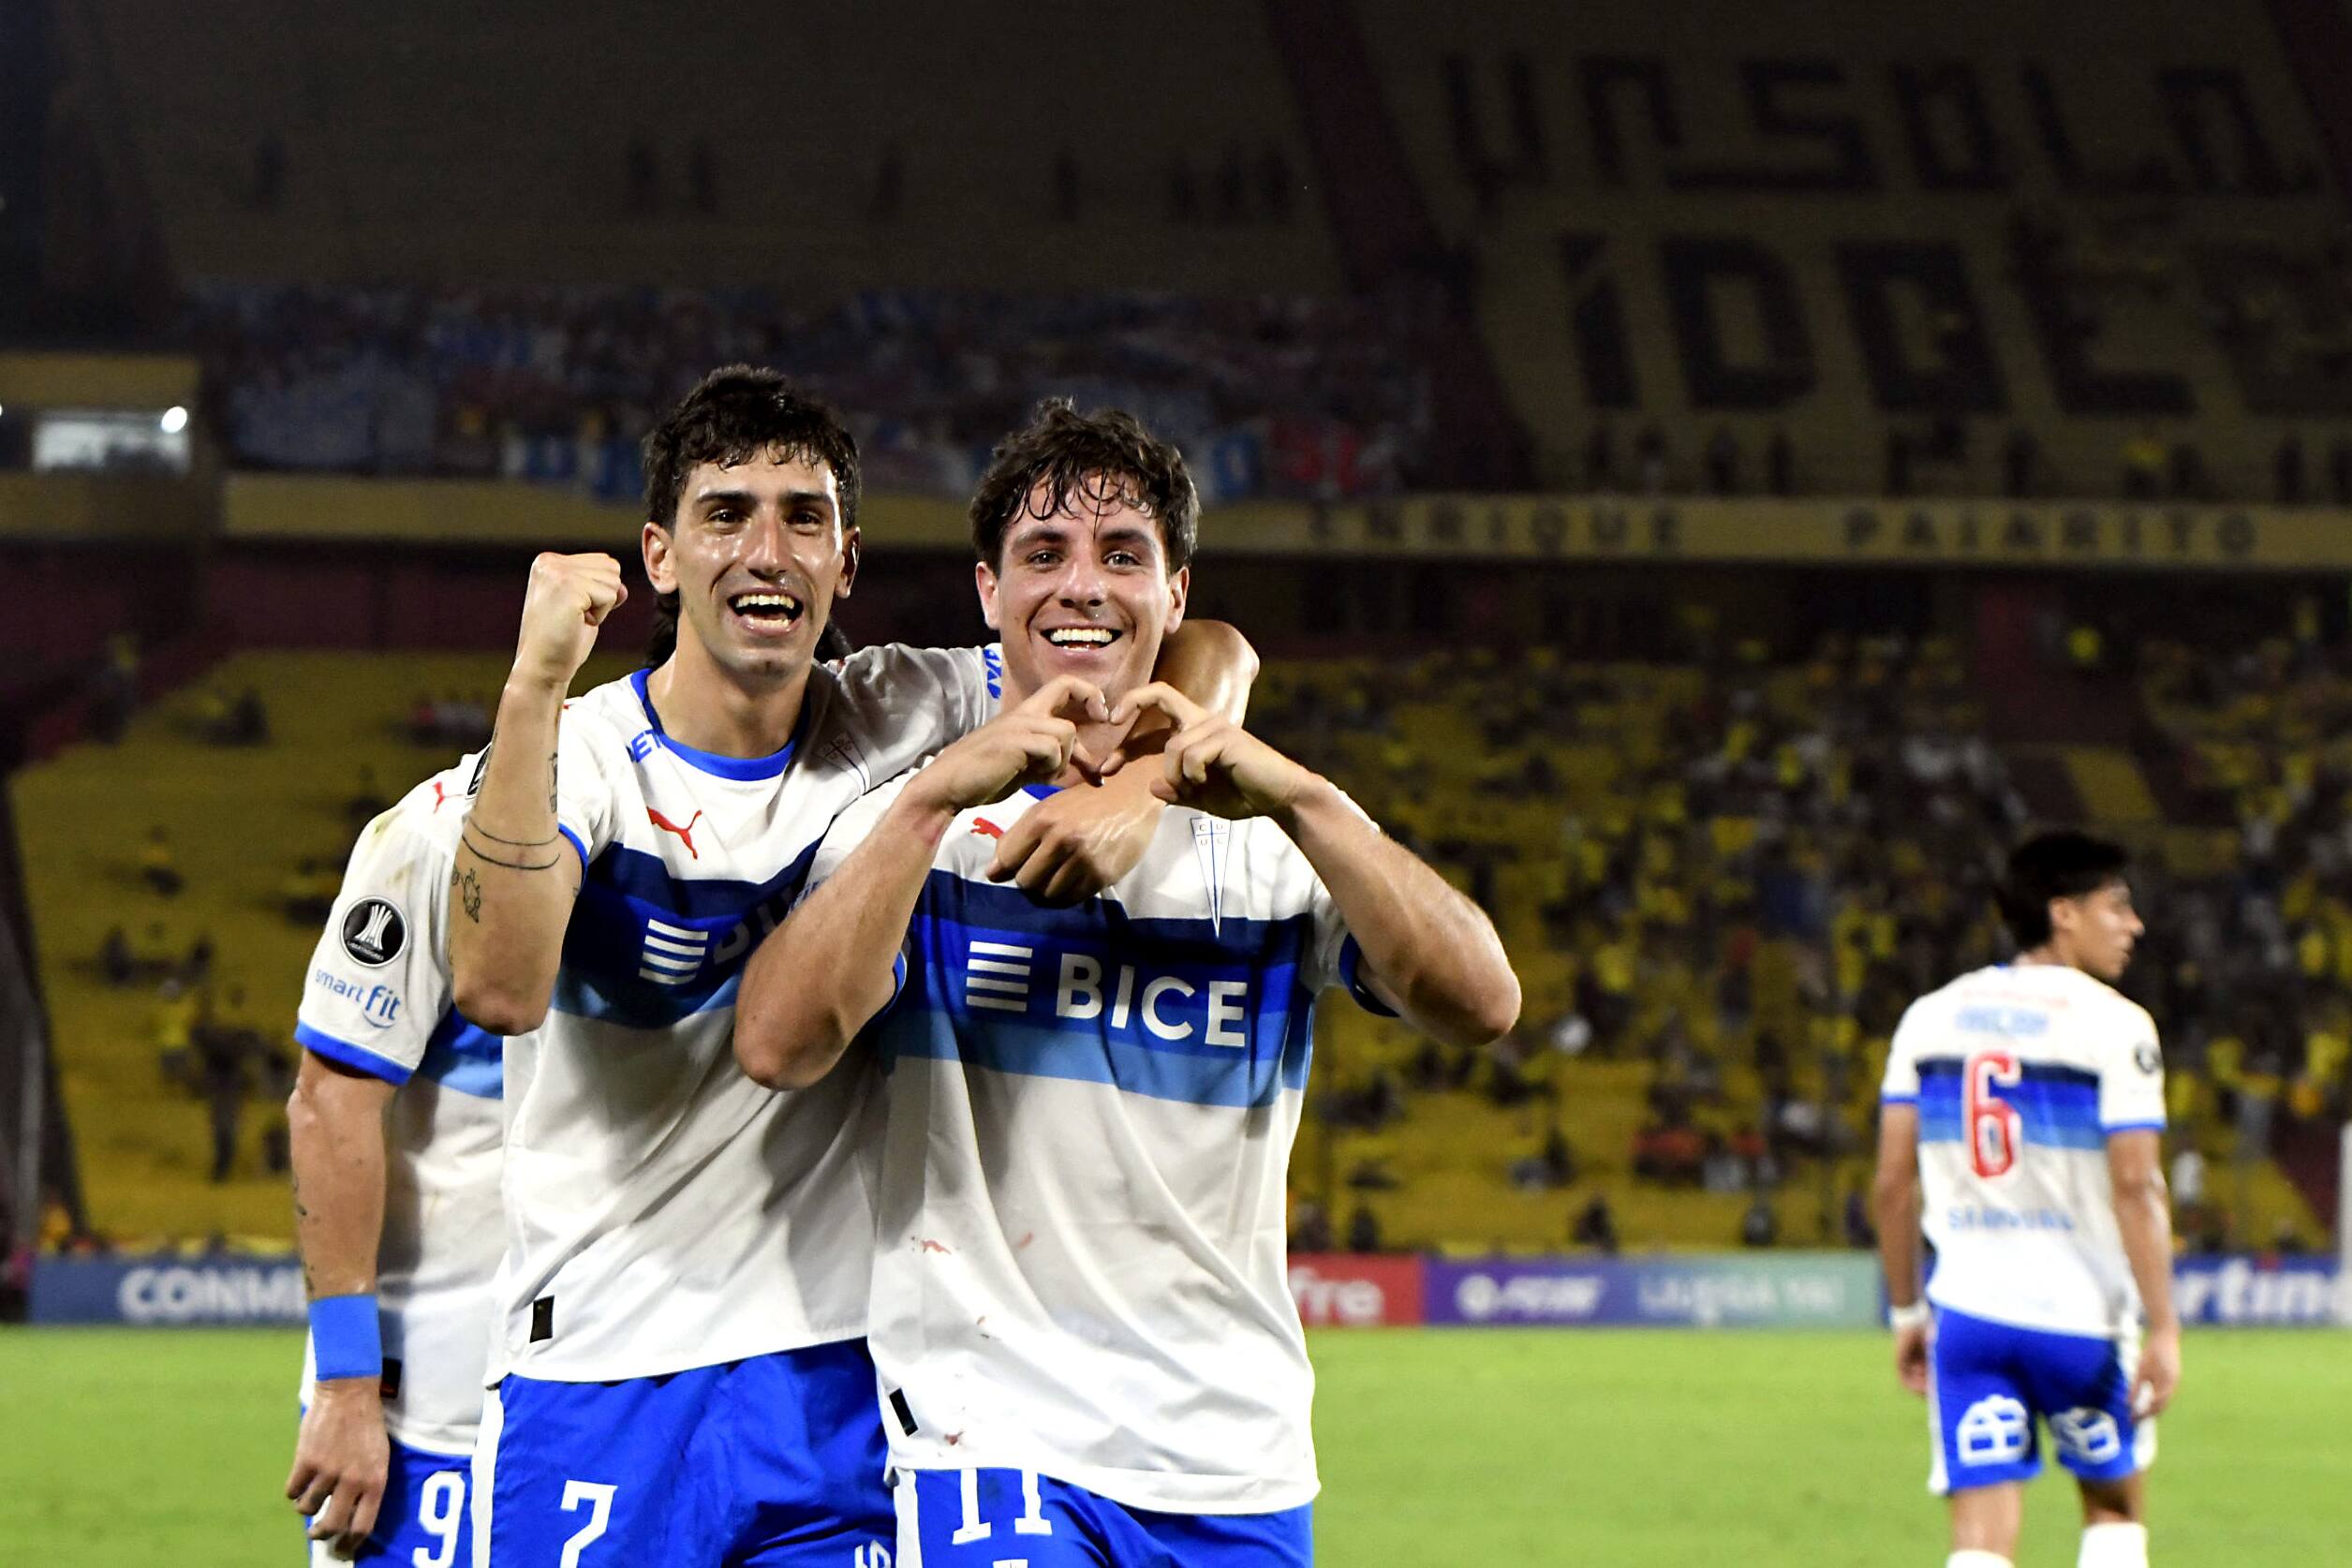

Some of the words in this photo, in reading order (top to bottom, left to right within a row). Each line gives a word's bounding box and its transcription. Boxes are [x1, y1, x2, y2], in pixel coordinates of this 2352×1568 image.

[316, 969, 363, 1002] smart
[364, 984, 401, 1021] fit
[1056, 953, 1248, 1047] BICE
[1965, 1050, 2021, 1182] 6
[119, 1267, 308, 1322] CONM
[2174, 1257, 2345, 1317] rtin
[412, 1471, 466, 1568] 9
[560, 1480, 618, 1568] 7
[952, 1468, 1053, 1546] 11
